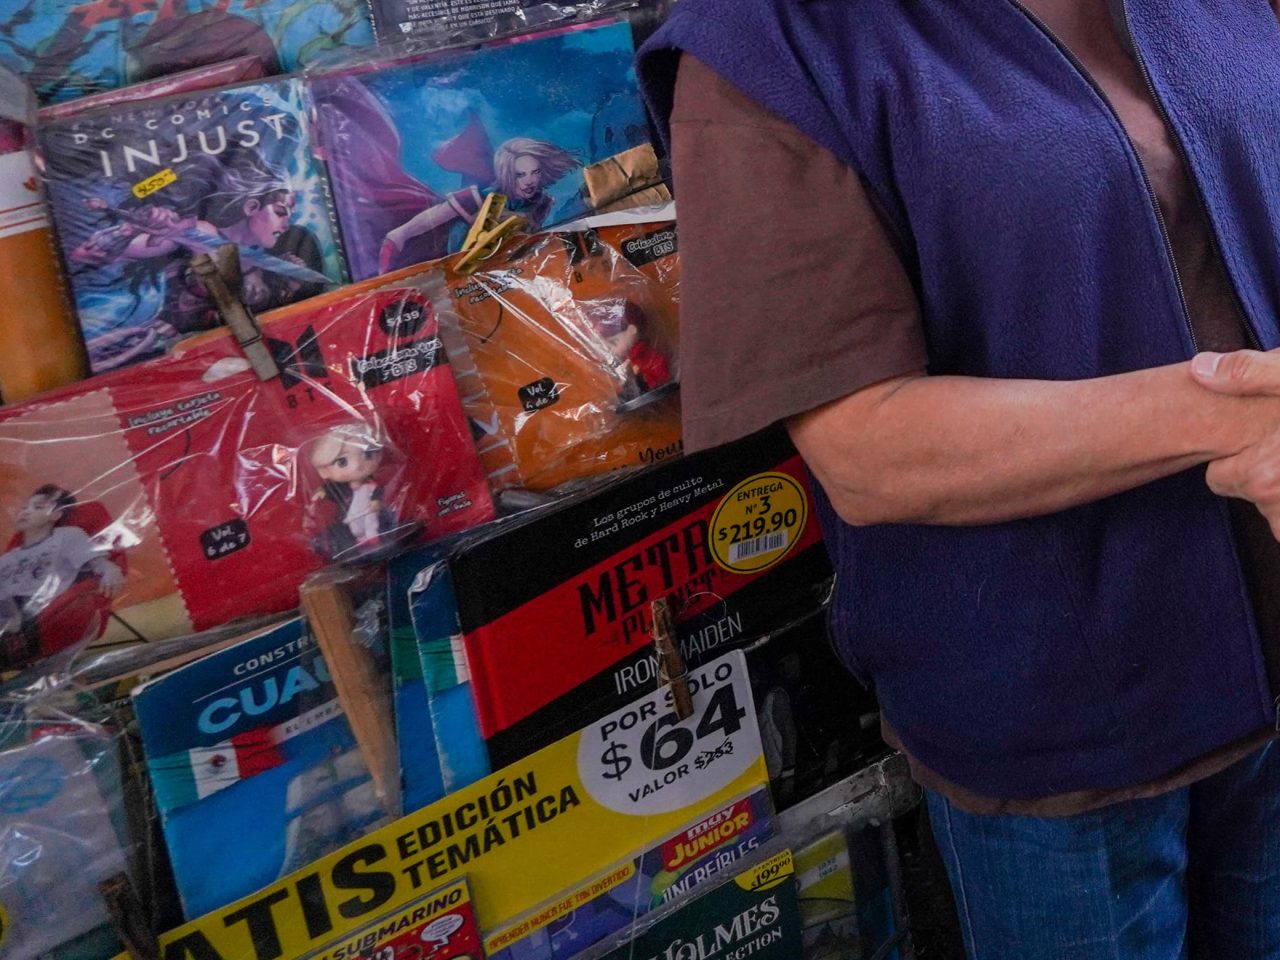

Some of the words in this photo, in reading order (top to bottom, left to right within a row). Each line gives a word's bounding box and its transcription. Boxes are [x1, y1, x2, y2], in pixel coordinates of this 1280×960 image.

[74, 126, 116, 145] DC
[145, 96, 273, 130] COMICS
[653, 242, 674, 256] BTS
[391, 359, 418, 377] BTS
[527, 385, 546, 396] Vol.
[593, 511, 615, 527] Los
[616, 495, 656, 521] grupos
[657, 486, 672, 500] de
[672, 476, 704, 494] culto
[736, 481, 784, 502] ENTREGA
[758, 496, 772, 516] 3
[211, 527, 236, 541] Vol.
[574, 537, 588, 549] de
[590, 523, 620, 543] Hard
[621, 511, 649, 530] Rock
[649, 507, 658, 518] y
[659, 493, 692, 513] Heavy
[693, 478, 725, 498] Metal
[718, 508, 798, 544] $219.90
[621, 567, 720, 645] PLNET
[233, 635, 311, 676] CONSTR
[614, 655, 660, 695] IRON
[600, 700, 657, 742] POR
[628, 764, 690, 803] VALOR
[397, 771, 538, 861] EDICIÓN
[402, 784, 581, 889] TEMÁTICA
[686, 805, 736, 840] muy
[667, 809, 750, 868] JUNIOR
[559, 900, 574, 916] FUE
[591, 867, 631, 897] DIVERTIDO
[332, 888, 463, 960] SUBMARINO
